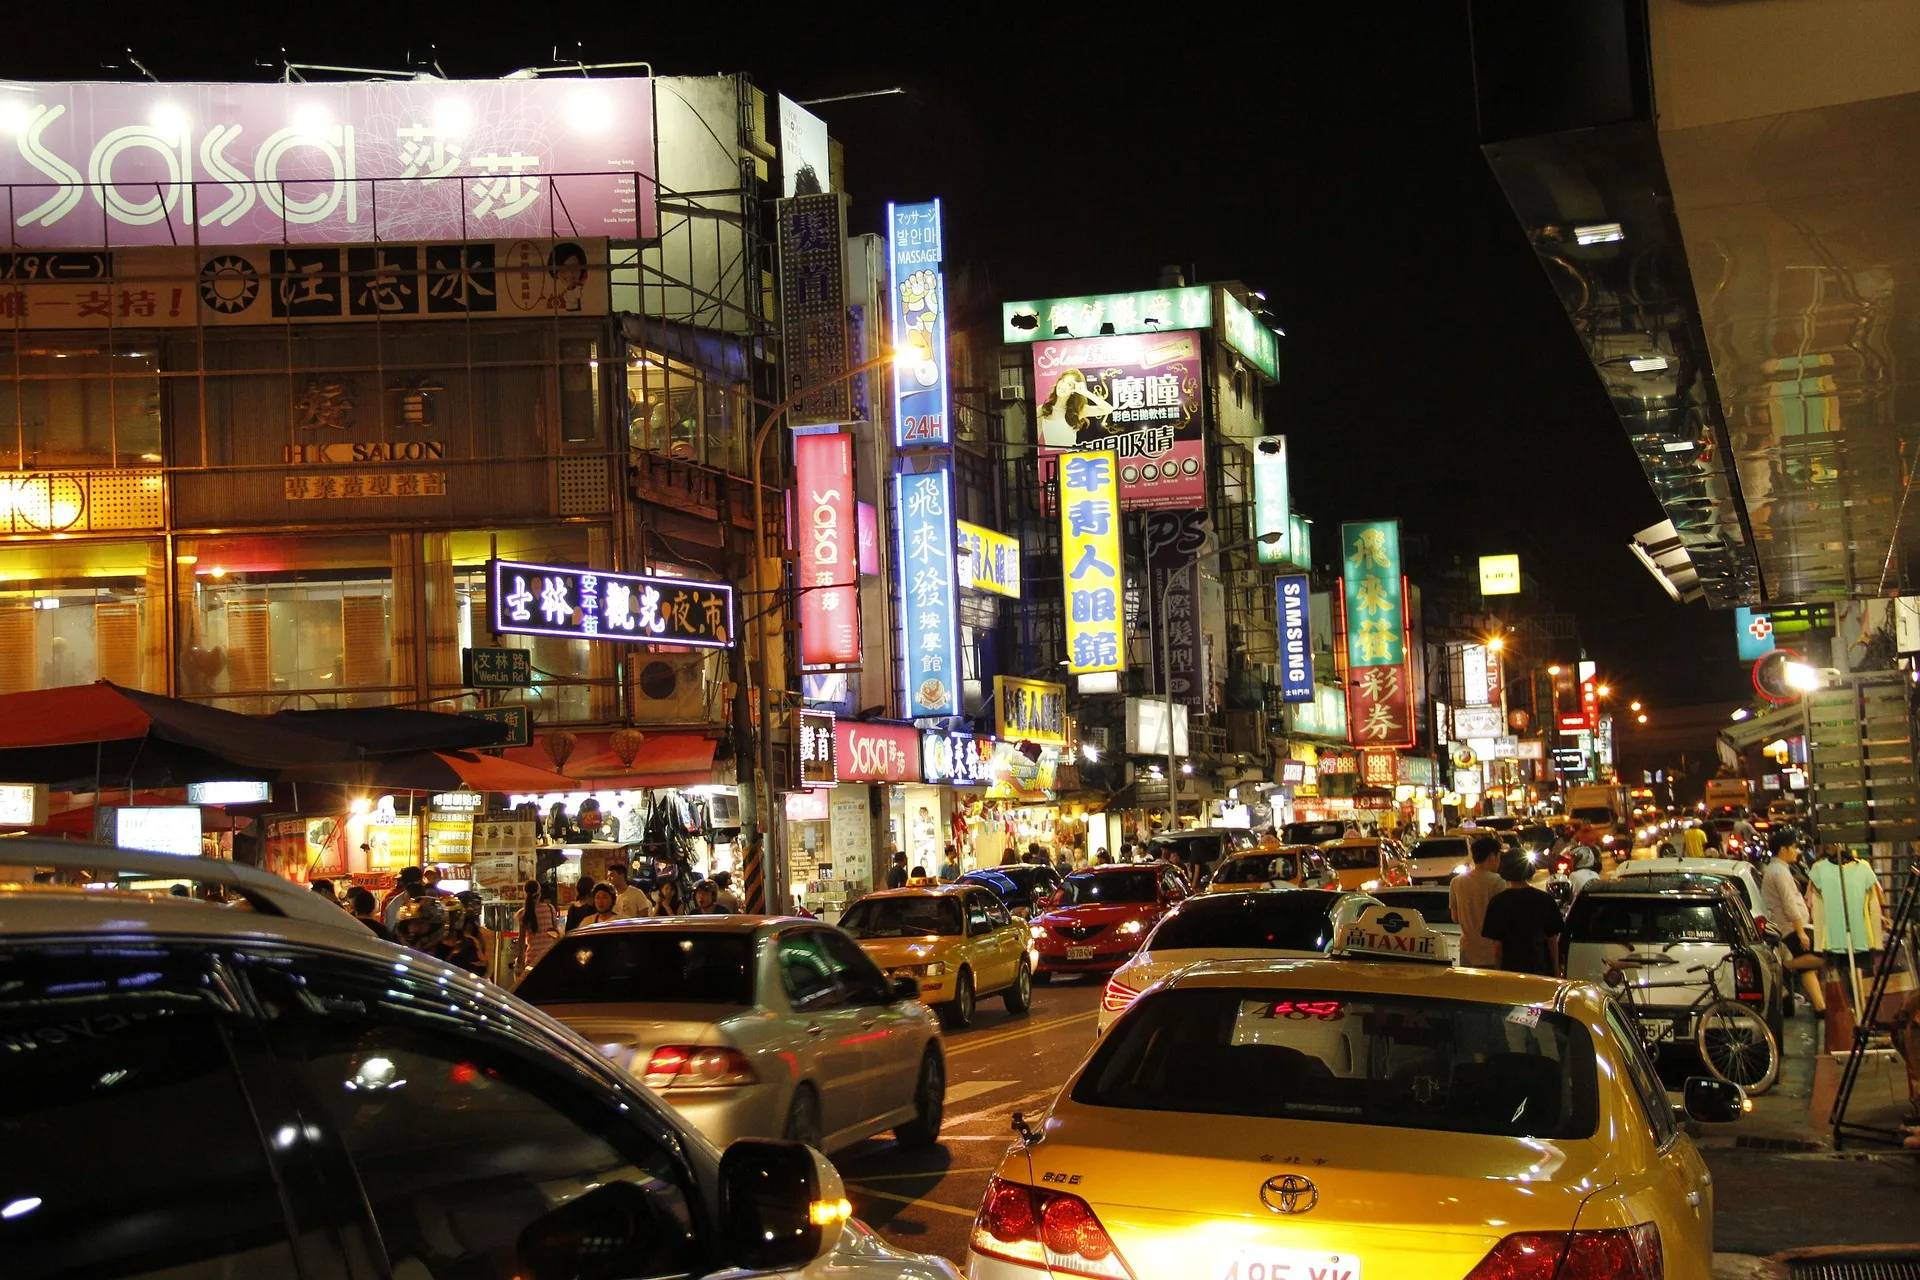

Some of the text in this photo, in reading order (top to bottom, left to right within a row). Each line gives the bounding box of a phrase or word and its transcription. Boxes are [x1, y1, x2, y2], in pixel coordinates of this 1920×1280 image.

[396, 123, 540, 221] 莎莎
[896, 210, 936, 225] マッサージ
[897, 228, 937, 246] 발안마
[897, 249, 938, 265] MASSAGE
[1111, 374, 1180, 411] 魔瞳
[904, 416, 944, 441] 24H
[353, 442, 445, 462] SALON
[816, 571, 840, 611] 莎莎
[1167, 567, 1195, 674] 國際髮型
[1284, 583, 1306, 682] SAMSUNG
[478, 653, 525, 670] 文林路
[1359, 667, 1402, 741] 彩券
[1366, 932, 1417, 952] TAXI
